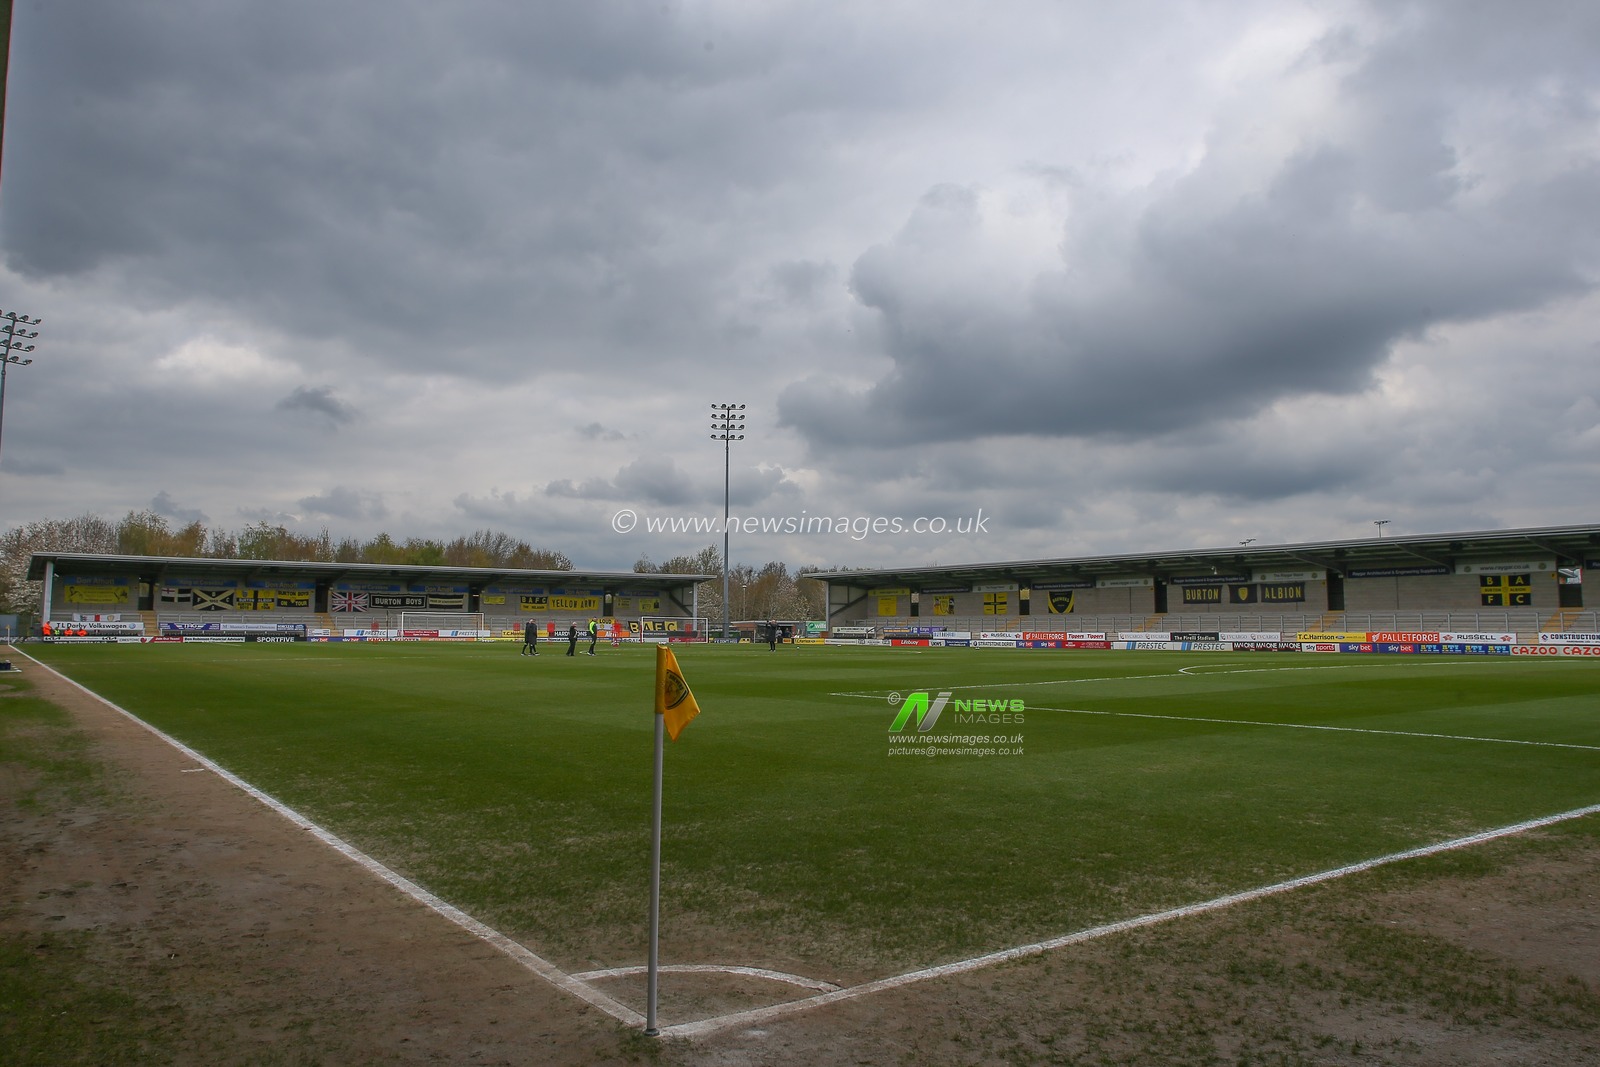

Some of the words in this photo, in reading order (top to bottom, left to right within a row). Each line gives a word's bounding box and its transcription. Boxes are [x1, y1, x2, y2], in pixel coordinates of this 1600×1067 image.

[1186, 588, 1219, 601] BURTON
[1264, 586, 1302, 599] ALBION
[375, 597, 402, 605] BURTON
[405, 597, 422, 605] BOYS
[66, 623, 88, 631] Darby
[89, 622, 128, 632] Volkswagen
[1382, 633, 1438, 642] PALLETFORCE
[1137, 642, 1167, 650] PRESTEC
[1193, 643, 1225, 651] PRESTEC
[1348, 644, 1359, 652] sky
[1388, 645, 1399, 653] sky
[1511, 646, 1558, 655] CAZOO
